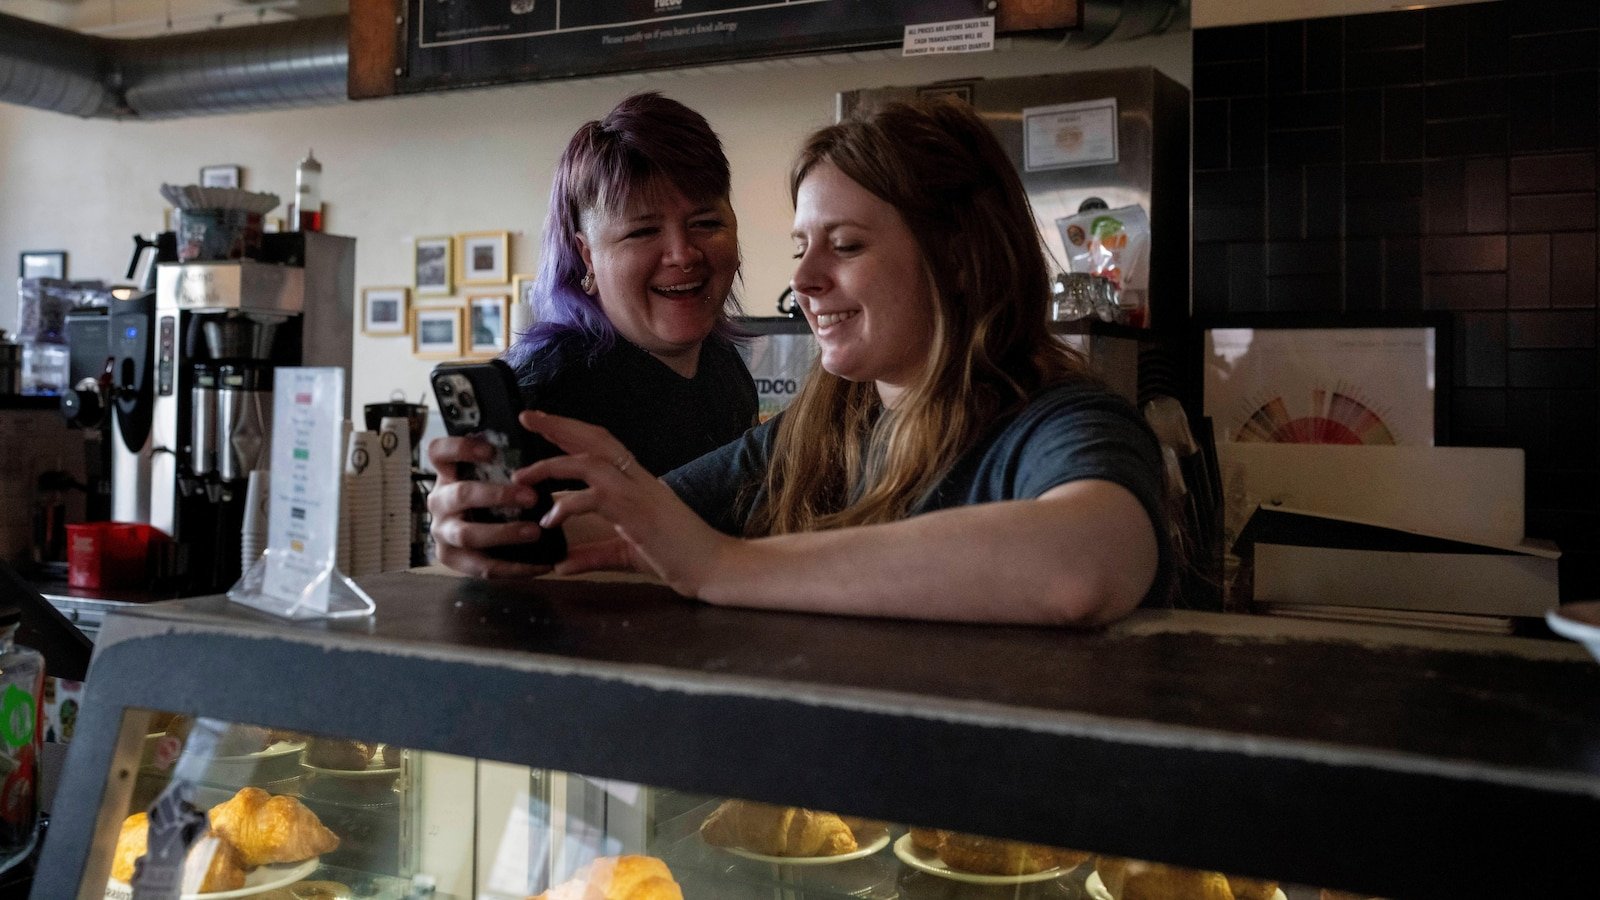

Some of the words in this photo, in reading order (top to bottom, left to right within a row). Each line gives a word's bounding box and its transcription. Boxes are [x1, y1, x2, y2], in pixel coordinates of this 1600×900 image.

[659, 30, 673, 40] you
[673, 26, 690, 36] have
[714, 21, 738, 33] allergy
[928, 34, 964, 43] TRANSACTIONS
